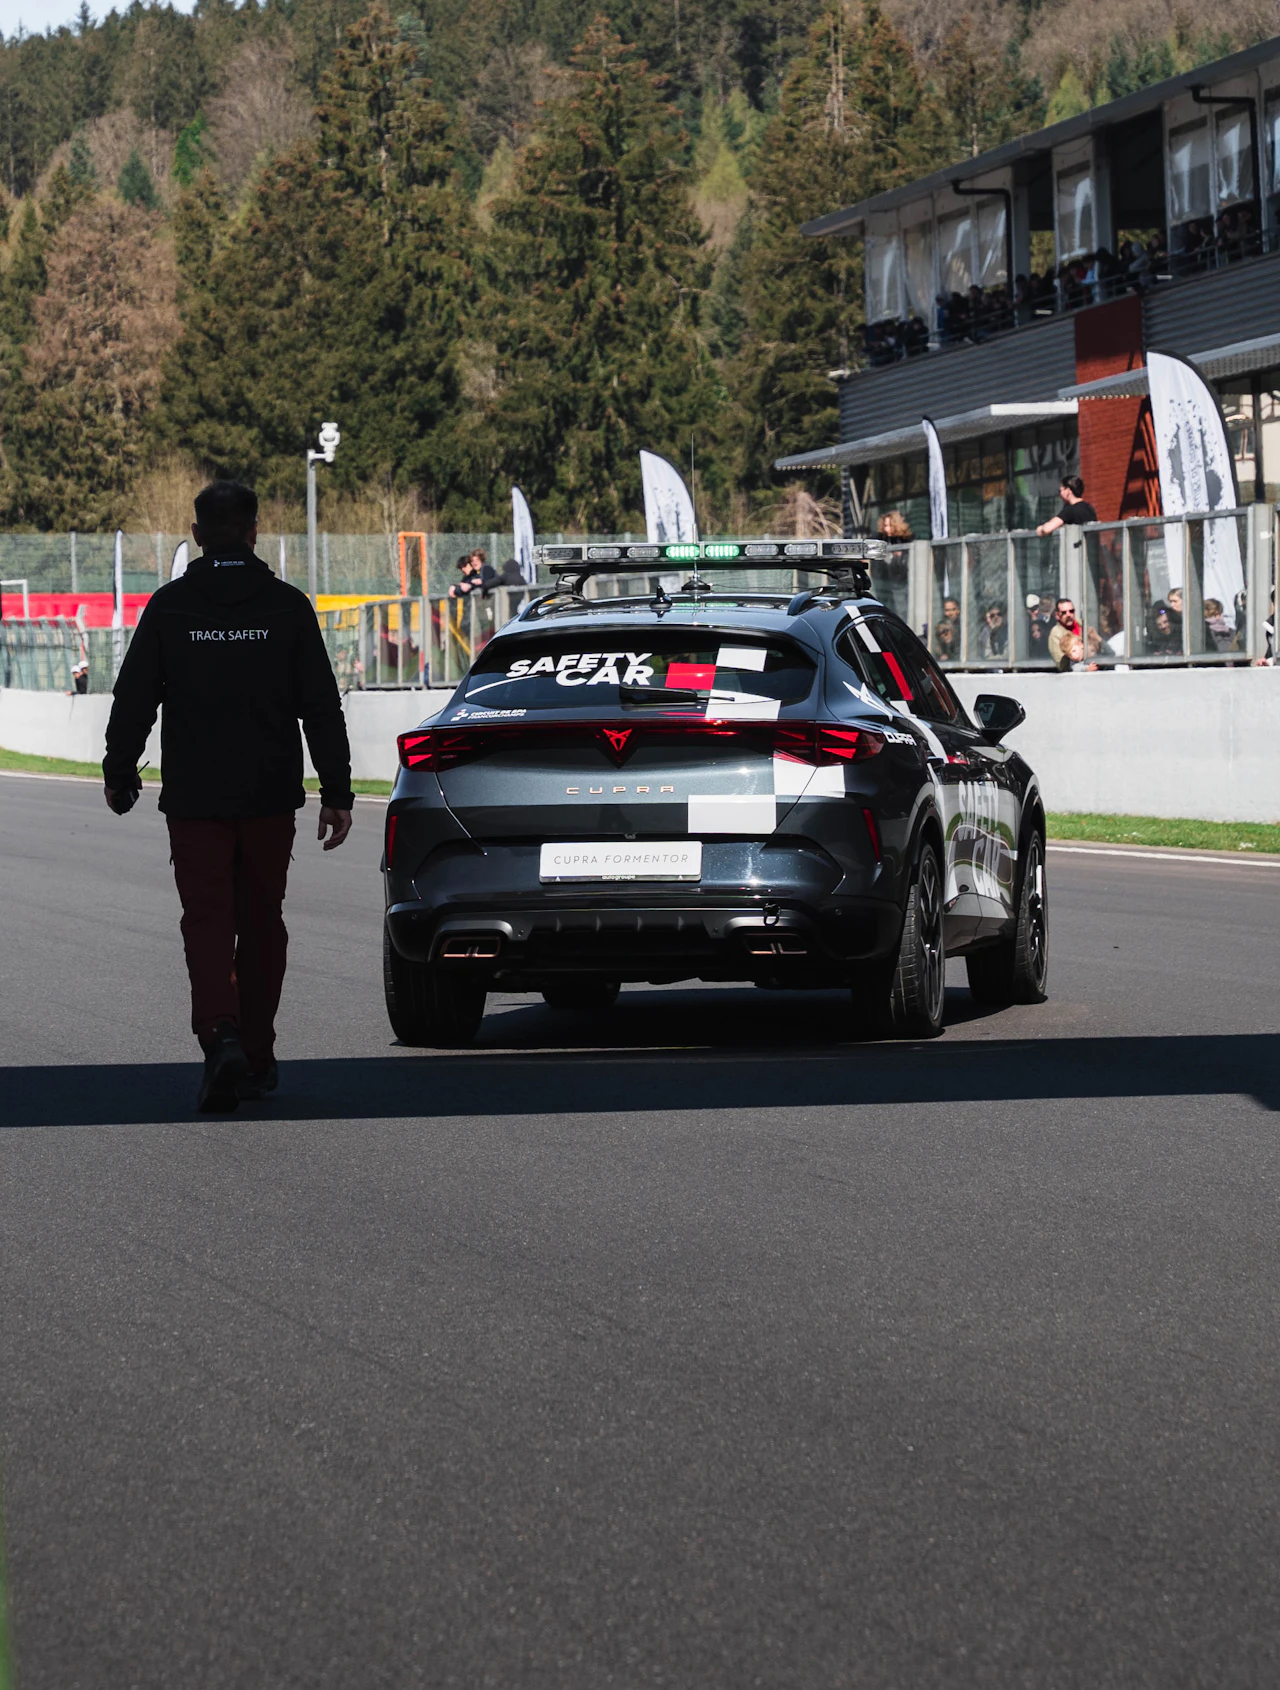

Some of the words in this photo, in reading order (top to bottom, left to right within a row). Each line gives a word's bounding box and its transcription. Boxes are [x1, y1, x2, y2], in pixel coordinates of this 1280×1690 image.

[189, 630, 226, 641] TRACK
[228, 629, 269, 641] SAFETY
[506, 652, 653, 678] SAFETY
[556, 665, 654, 686] CAR
[883, 731, 918, 746] CUPRA
[566, 785, 674, 794] CUPRA
[958, 780, 999, 841] SAFETY
[554, 855, 599, 865] CUPRA
[604, 854, 690, 864] FORMENTOR
[972, 830, 1001, 898] CAR
